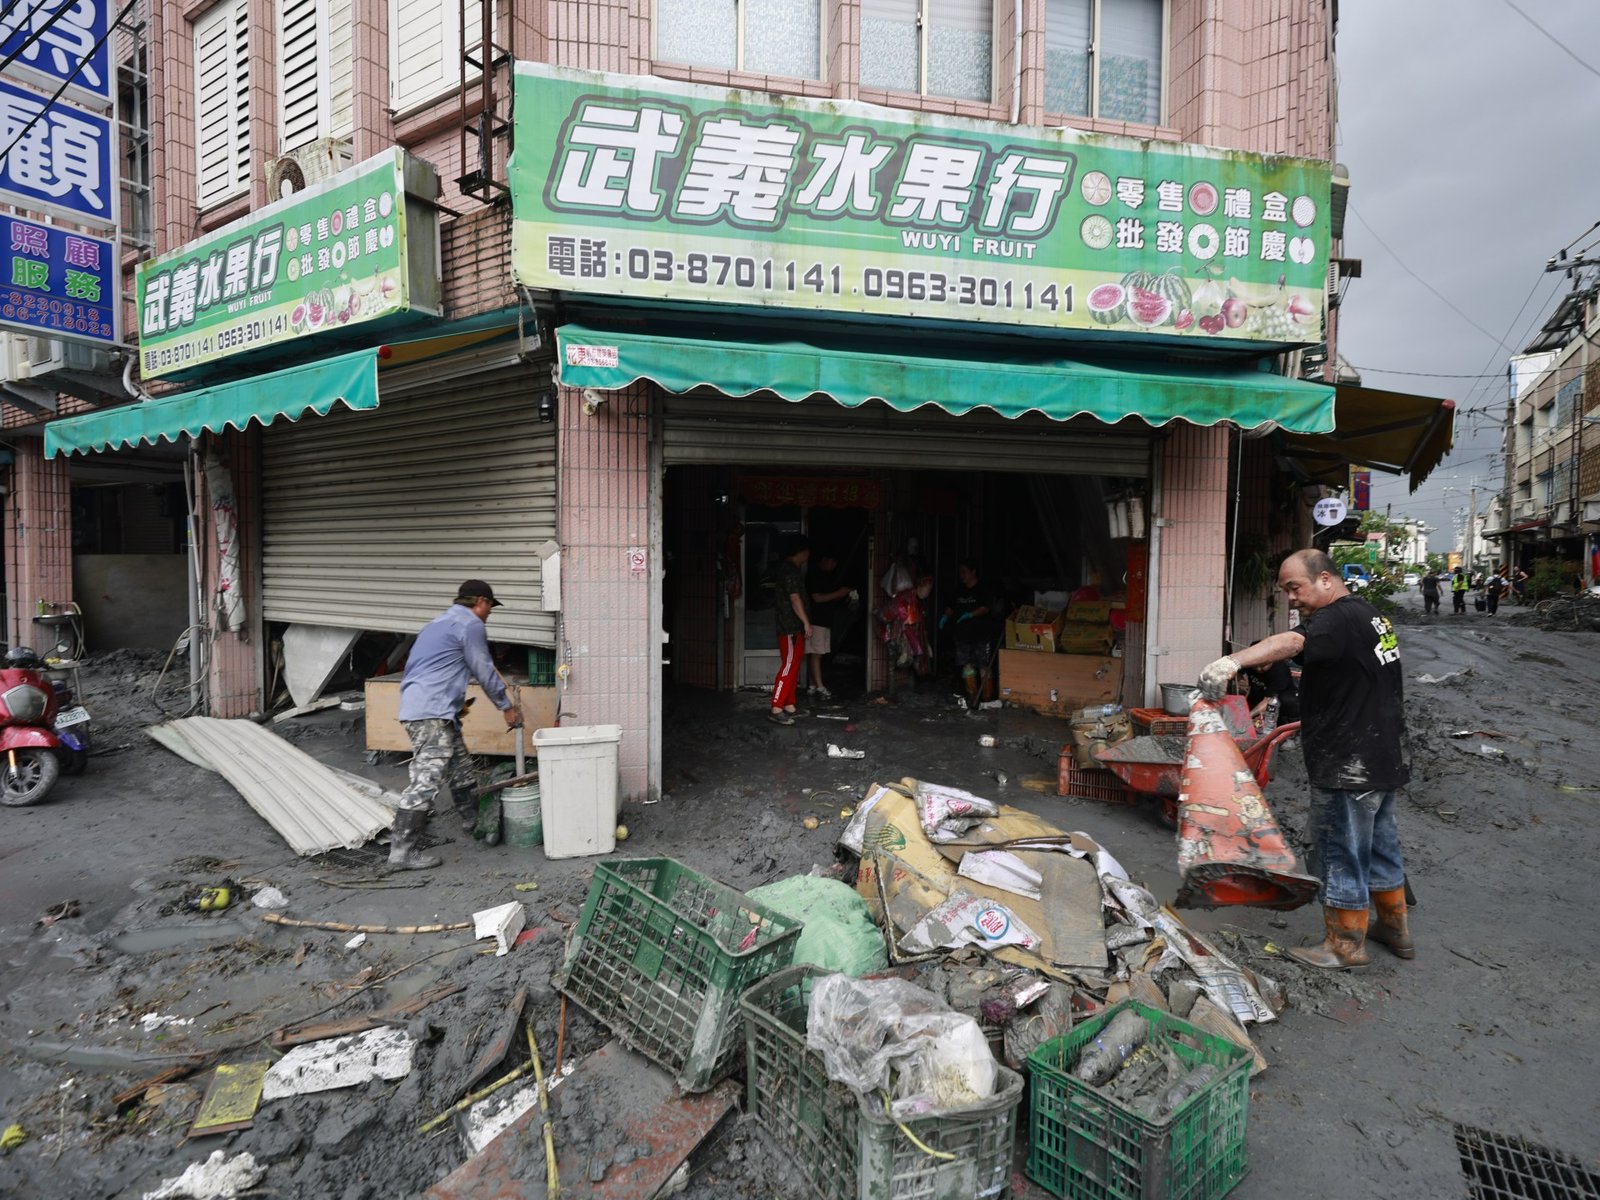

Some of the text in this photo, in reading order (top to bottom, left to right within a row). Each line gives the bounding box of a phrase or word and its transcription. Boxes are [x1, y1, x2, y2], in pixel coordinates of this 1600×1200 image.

[555, 105, 1067, 232] 武義水果行
[902, 231, 1036, 259] WUYI FRUIT
[143, 229, 282, 336] 武義水果行
[227, 291, 273, 313] WUYI FRUIT
